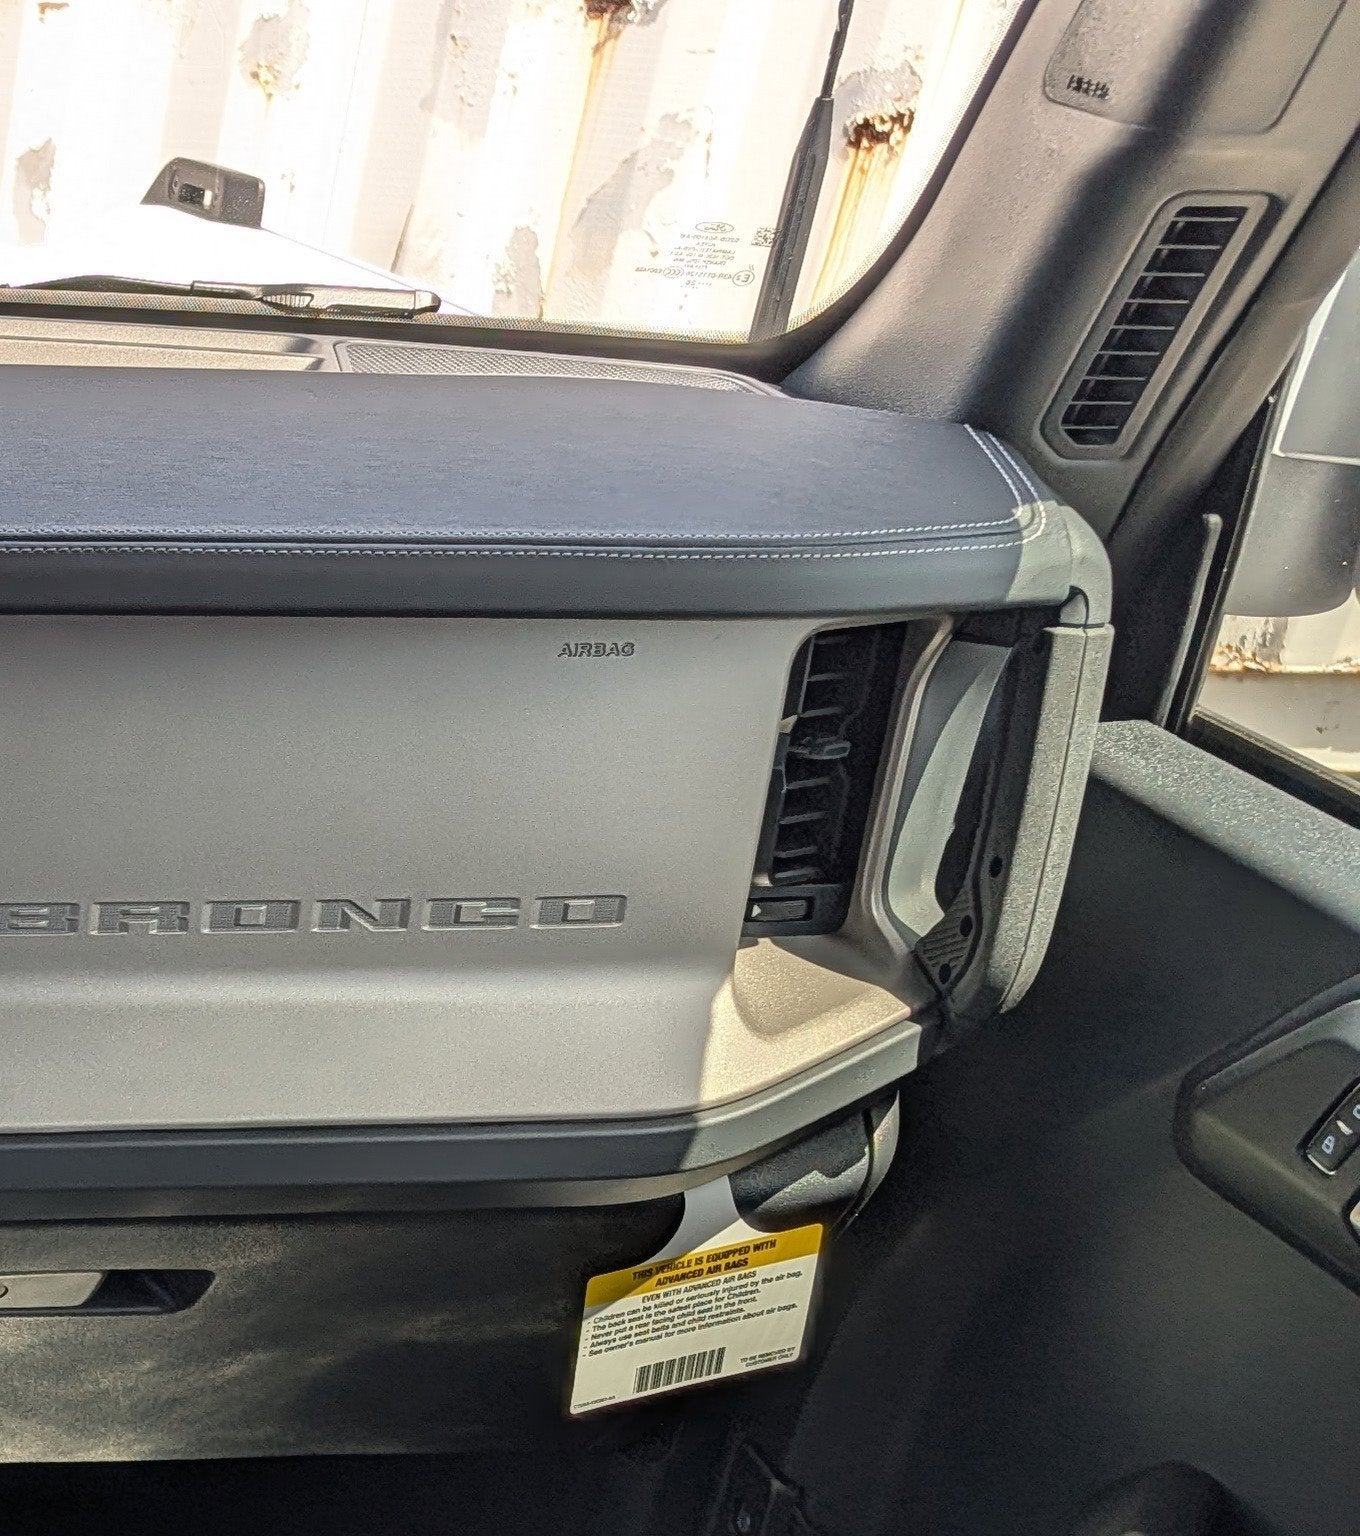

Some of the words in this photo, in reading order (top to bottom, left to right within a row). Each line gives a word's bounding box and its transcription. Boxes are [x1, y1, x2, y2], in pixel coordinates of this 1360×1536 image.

[557, 641, 636, 658] AIRBAG
[655, 1258, 691, 1274] VEHICLE
[706, 1244, 749, 1263] EQUIPPED
[752, 1238, 776, 1252] WITH
[655, 1267, 704, 1287] ADVANCED
[724, 1257, 748, 1270] BAGS
[683, 1278, 720, 1293] ADVANCED
[737, 1269, 756, 1280] BAGS
[686, 1287, 720, 1303] seriously
